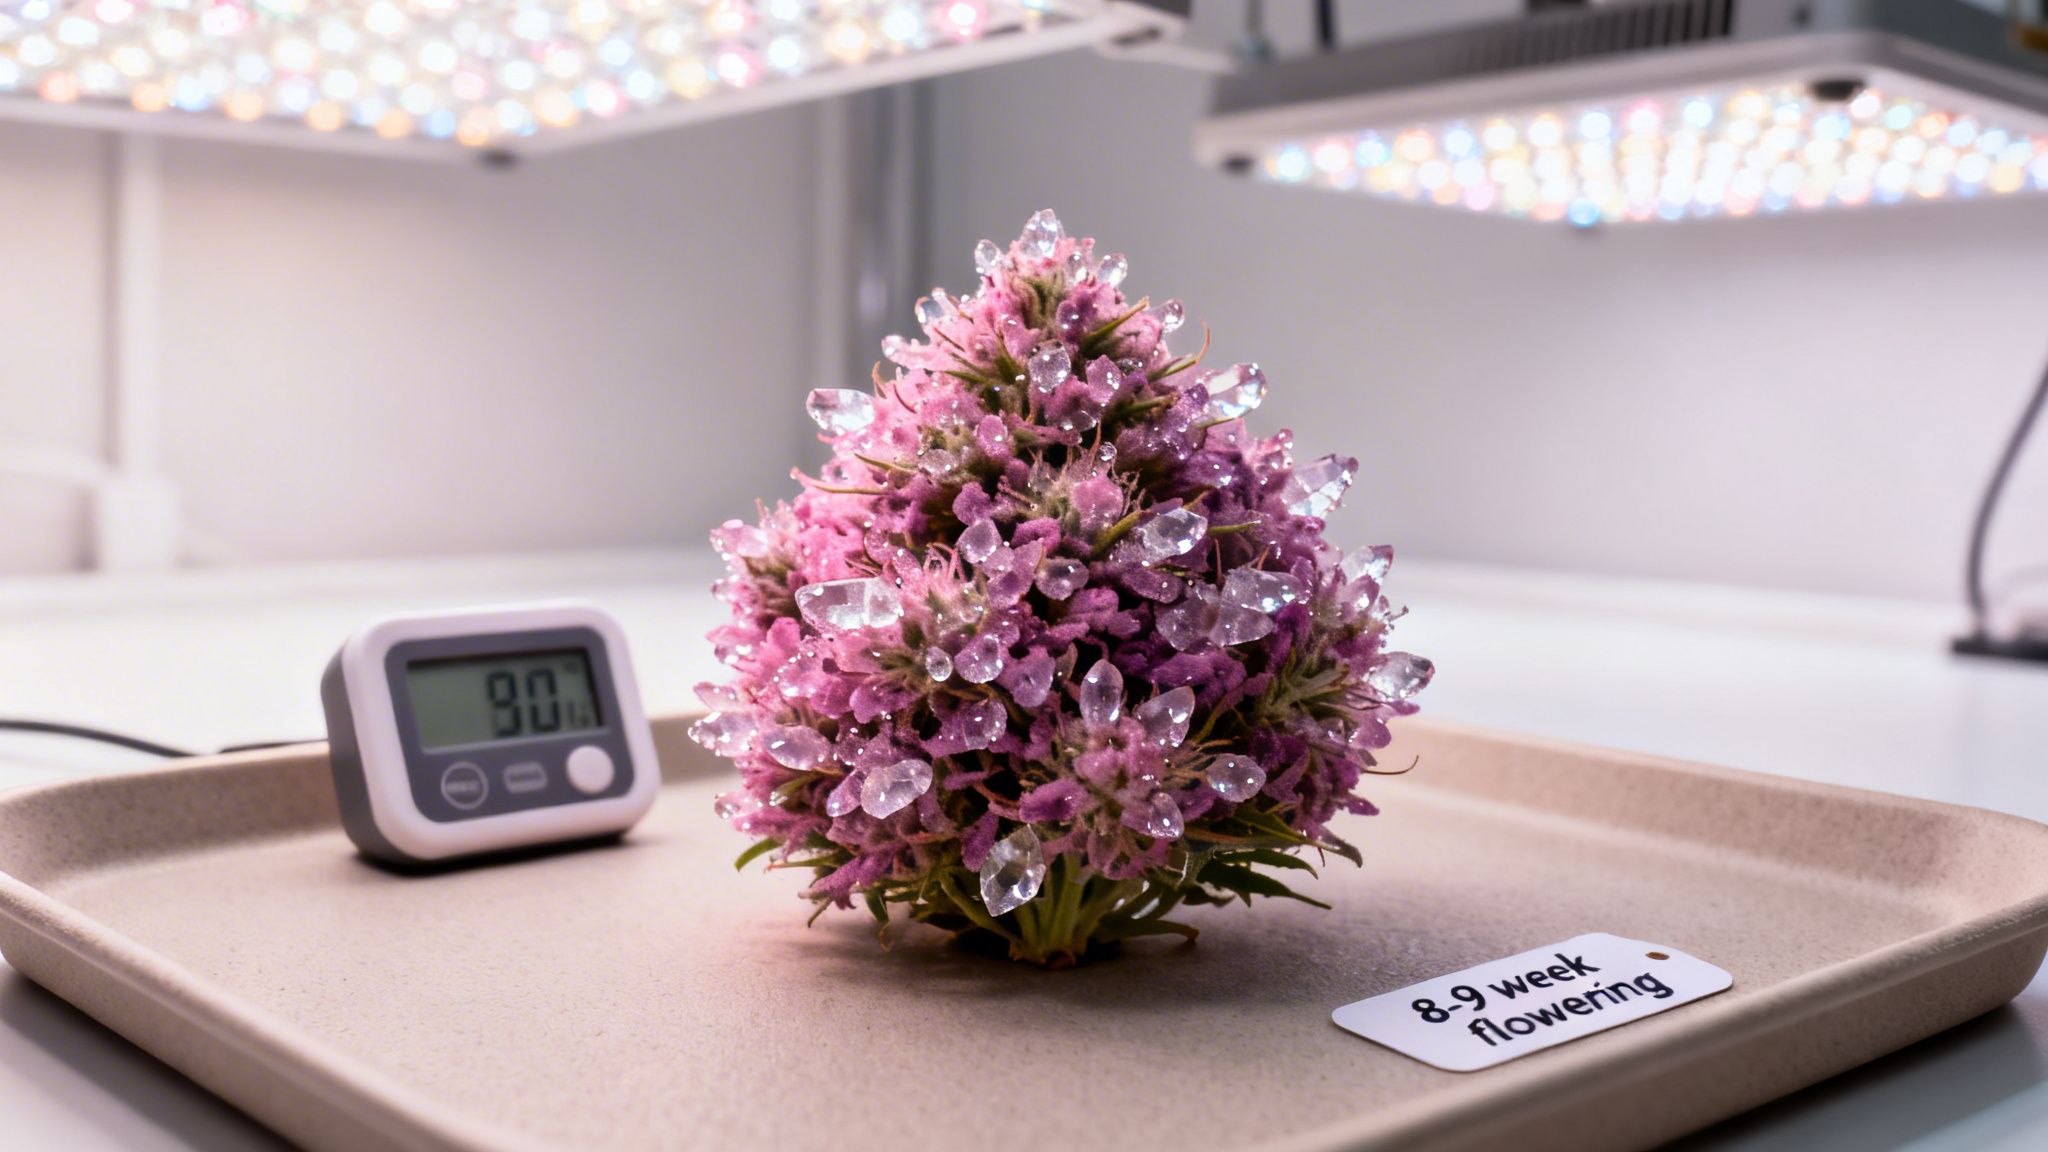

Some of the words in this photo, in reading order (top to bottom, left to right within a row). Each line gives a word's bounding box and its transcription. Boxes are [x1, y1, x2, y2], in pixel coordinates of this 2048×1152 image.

[1411, 985, 1486, 1024] 8-9
[1489, 953, 1600, 1000] week
[1468, 972, 1674, 1047] flowering
